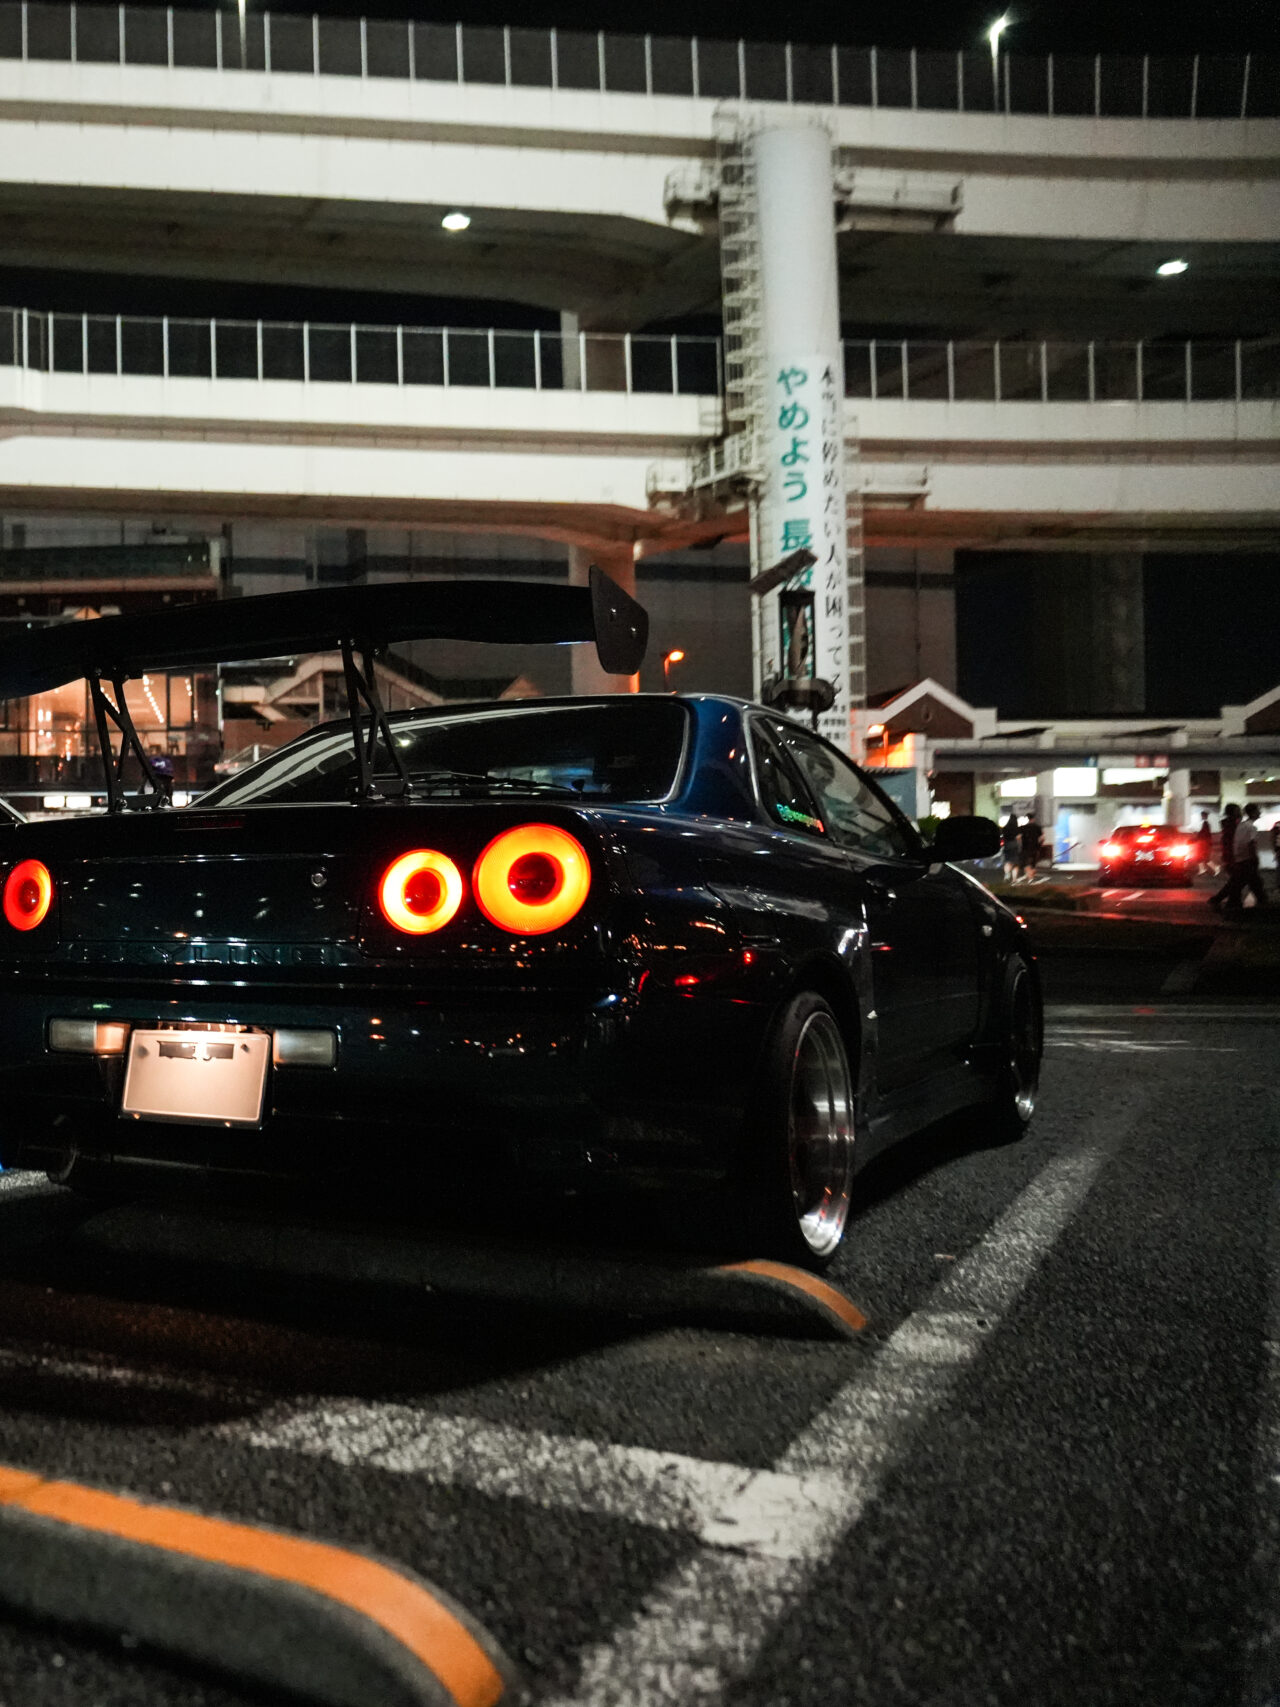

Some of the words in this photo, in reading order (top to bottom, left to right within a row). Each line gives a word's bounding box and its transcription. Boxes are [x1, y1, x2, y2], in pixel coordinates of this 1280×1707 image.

[776, 367, 810, 501] やめよう
[76, 944, 324, 966] YLINE
